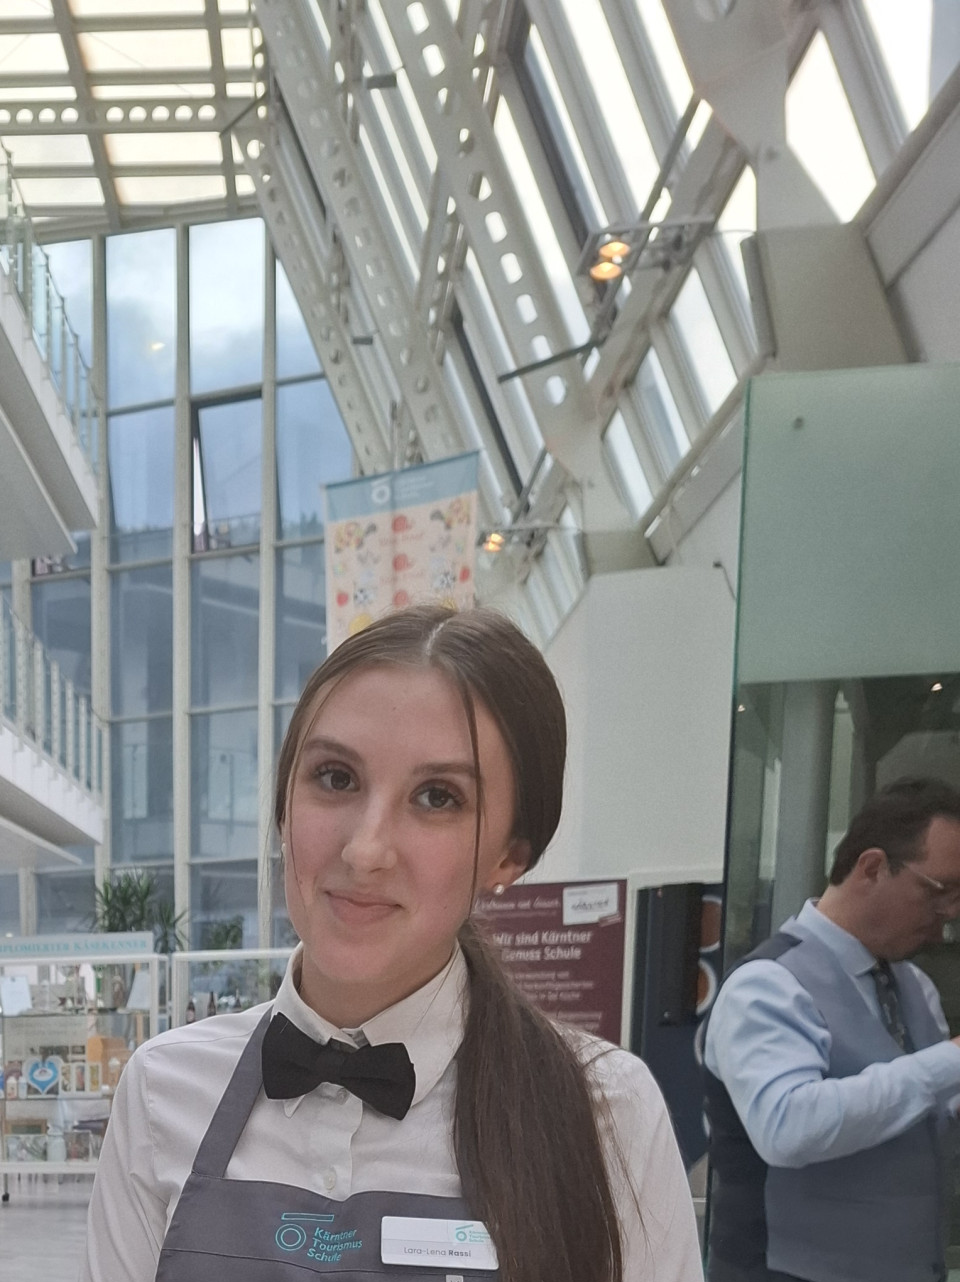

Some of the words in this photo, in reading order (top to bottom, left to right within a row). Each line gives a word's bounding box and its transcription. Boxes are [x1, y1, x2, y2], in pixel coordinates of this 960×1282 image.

[516, 931, 538, 945] sind
[542, 930, 591, 944] Kärntner
[544, 947, 581, 960] Schule
[314, 1227, 357, 1241] Kärntner
[312, 1238, 362, 1252] Tourismus
[404, 1246, 446, 1256] Lara-Lena
[448, 1249, 472, 1258] Rassi
[307, 1248, 342, 1262] Schule
